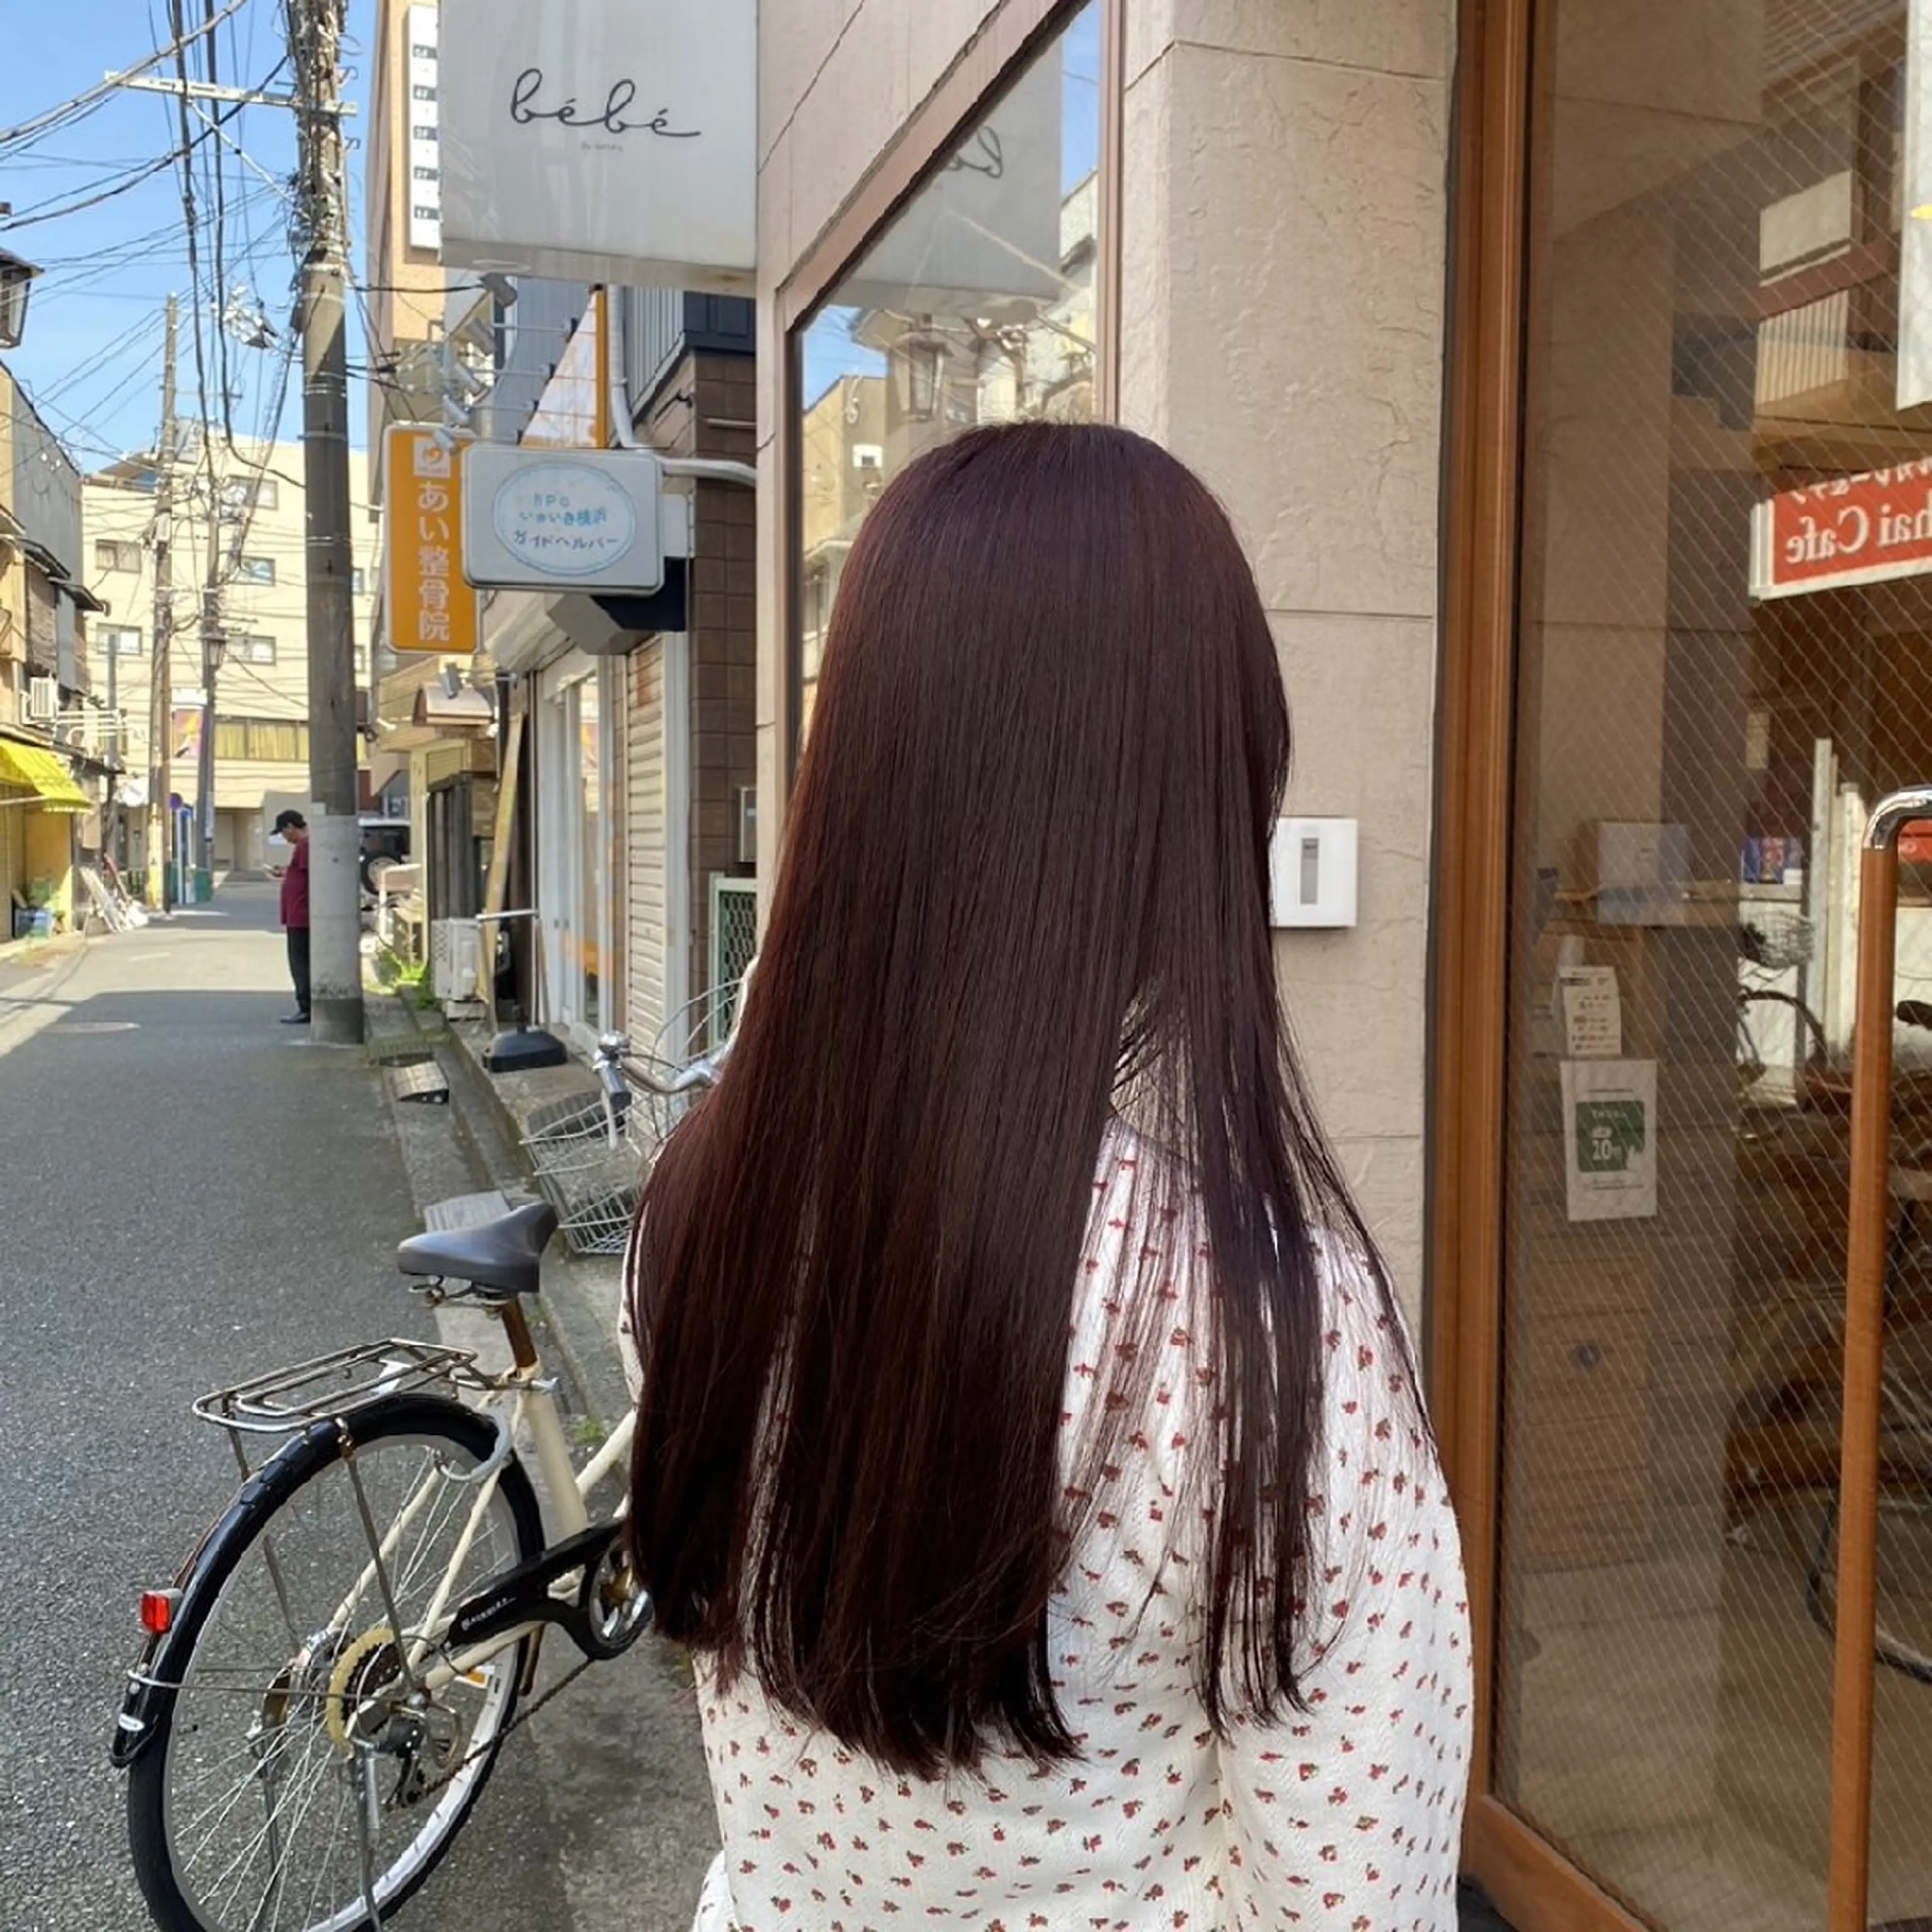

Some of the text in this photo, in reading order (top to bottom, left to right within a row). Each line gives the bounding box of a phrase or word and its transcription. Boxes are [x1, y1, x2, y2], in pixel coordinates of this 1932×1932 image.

[510, 68, 702, 137] bébé
[418, 481, 449, 641] あい整骨院
